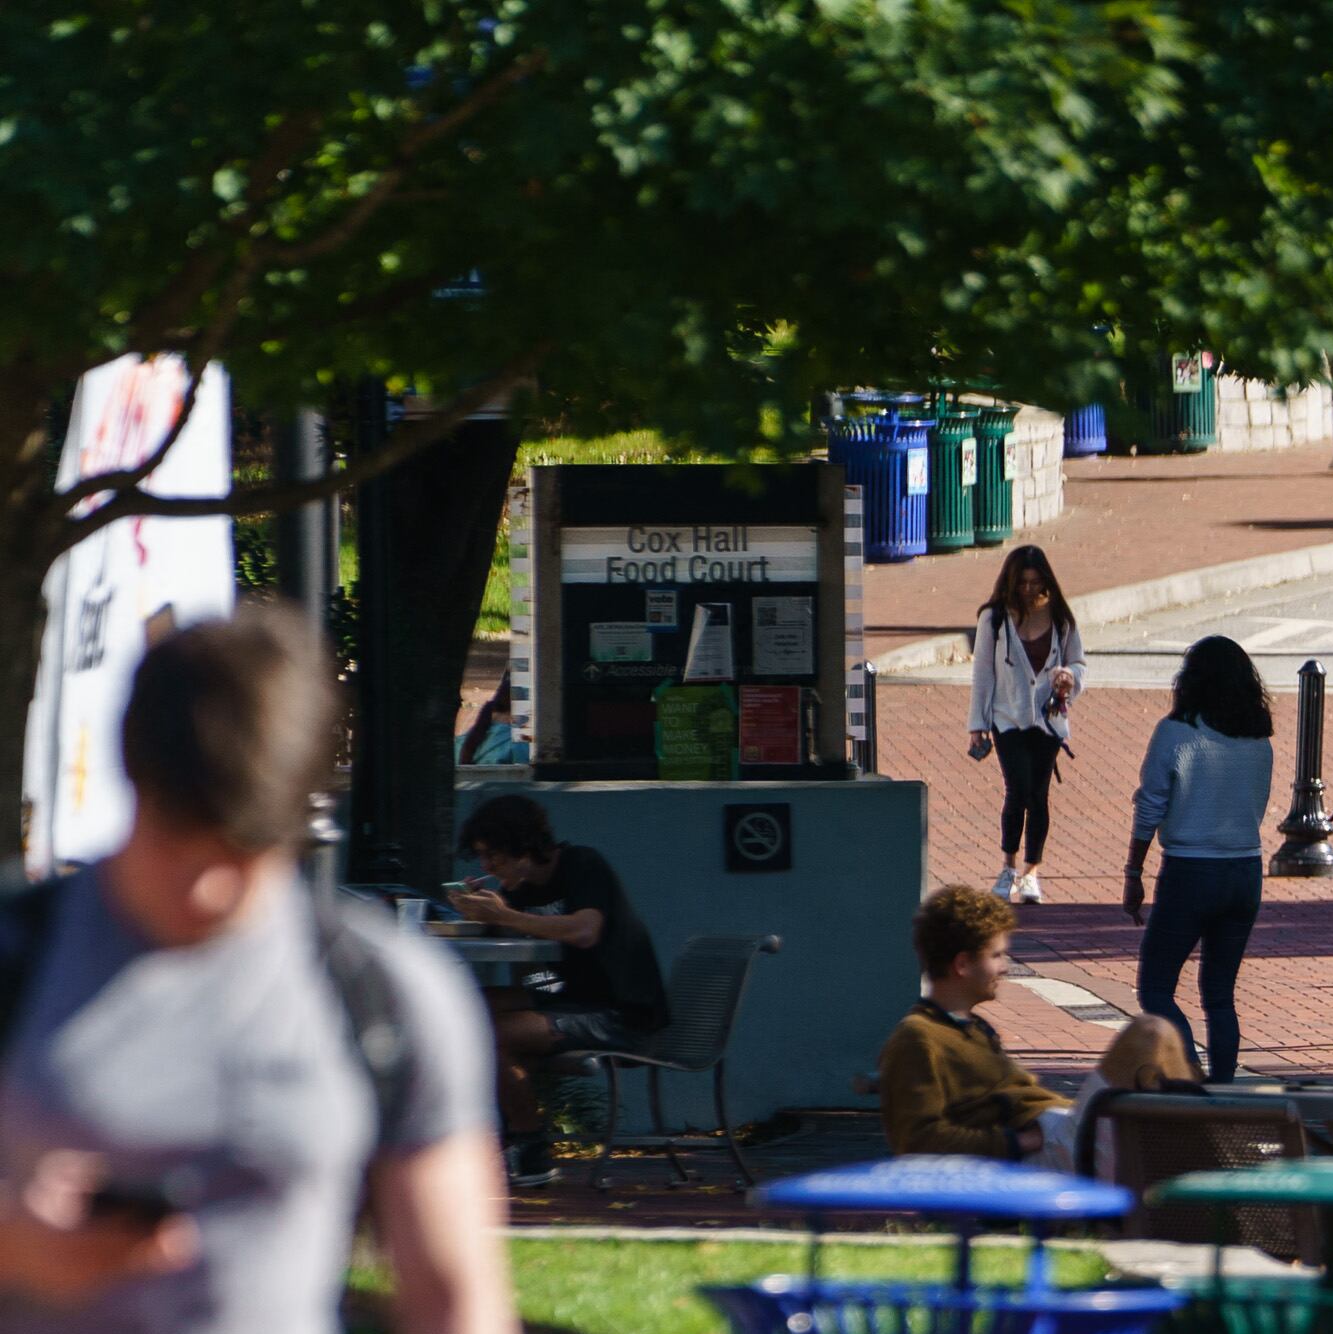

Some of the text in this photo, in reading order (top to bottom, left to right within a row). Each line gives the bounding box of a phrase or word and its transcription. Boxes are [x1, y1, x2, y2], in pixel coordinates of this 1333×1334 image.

[627, 527, 748, 553] Cox Hall
[606, 555, 771, 582] Food Court
[605, 664, 678, 677] Accessible
[663, 703, 697, 713] WANT
[663, 717, 679, 727] TO
[663, 730, 697, 741] MAKE
[663, 743, 707, 754] MONEY
